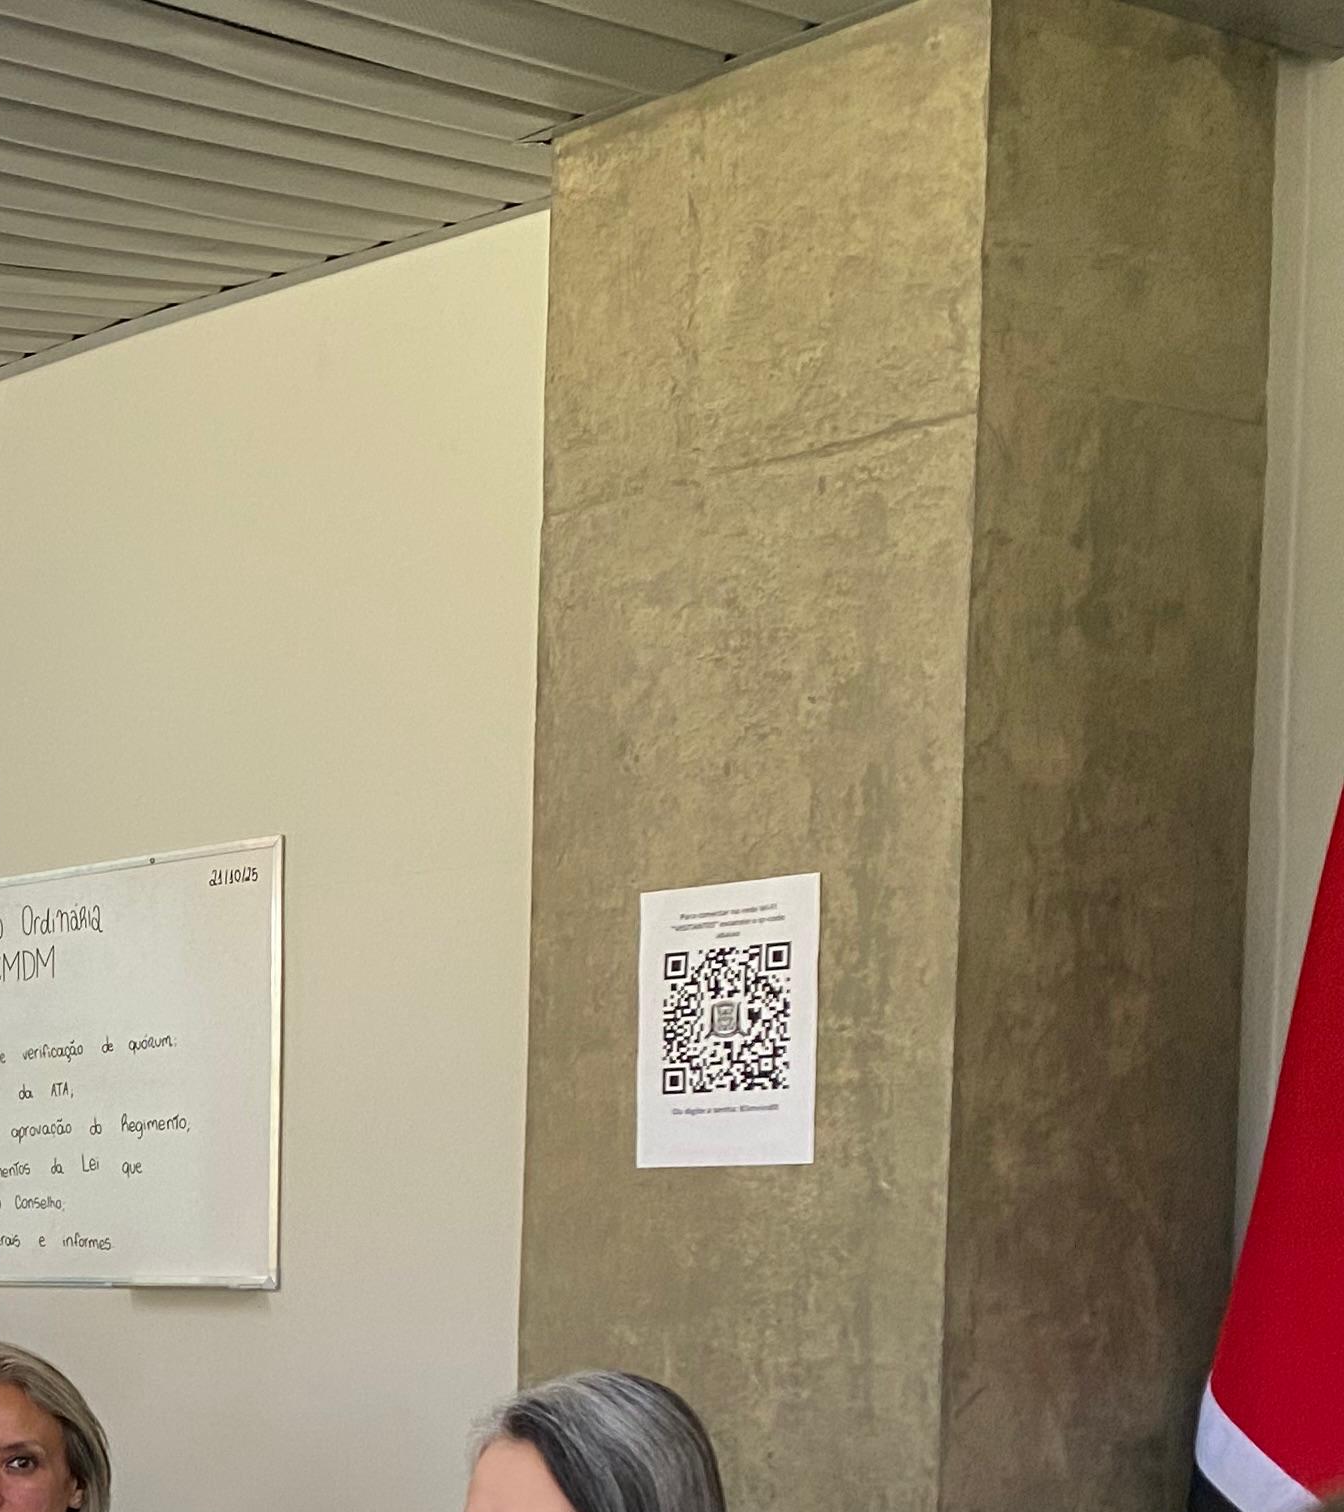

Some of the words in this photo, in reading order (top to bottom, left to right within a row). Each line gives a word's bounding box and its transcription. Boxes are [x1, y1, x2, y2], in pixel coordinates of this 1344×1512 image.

[209, 866, 259, 887] 21/10/25
[0, 1052, 6, 1064] e
[22, 1039, 84, 1063] verificação
[101, 1035, 114, 1054] de
[18, 1083, 34, 1100] da
[10, 1117, 72, 1144] aprovação
[89, 1115, 102, 1136] do
[50, 1157, 64, 1175] da
[81, 1153, 99, 1173] Lei
[121, 1161, 143, 1179] que
[38, 1235, 47, 1248] e
